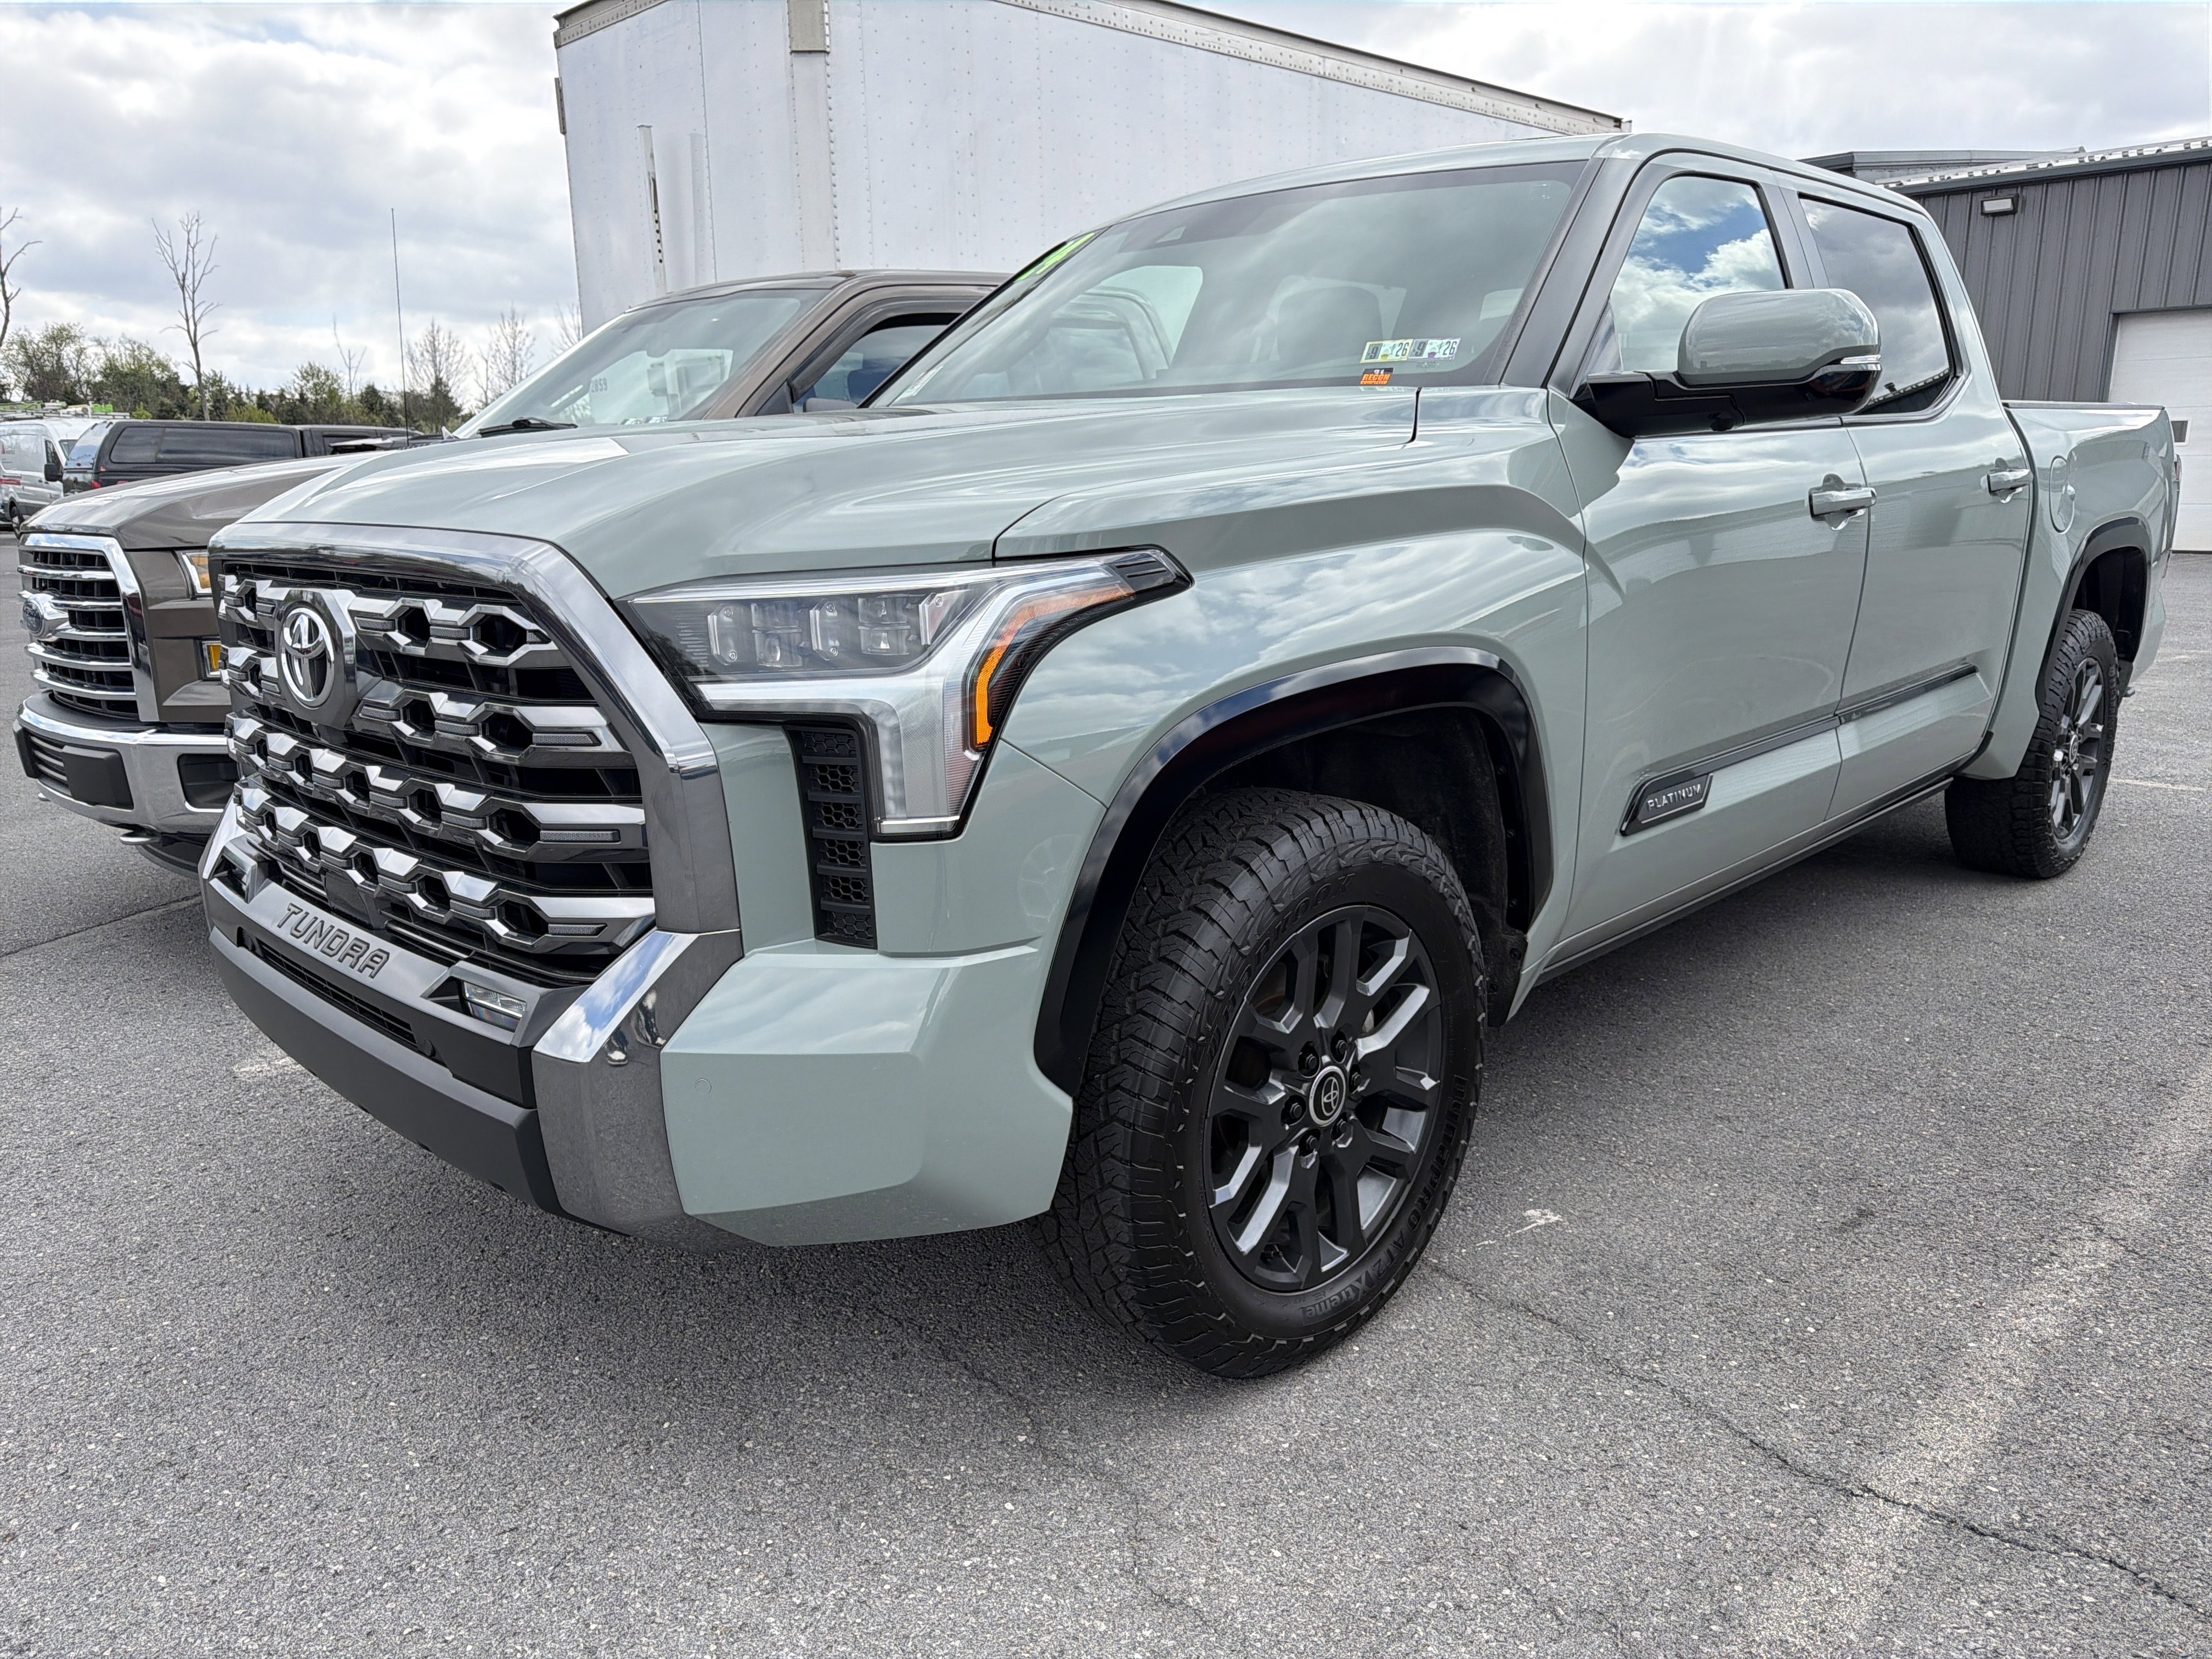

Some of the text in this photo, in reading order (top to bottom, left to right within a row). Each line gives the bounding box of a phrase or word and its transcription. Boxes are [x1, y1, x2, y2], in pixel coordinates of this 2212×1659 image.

[1395, 342, 1409, 357] 26
[1443, 341, 1457, 356] 26
[1647, 783, 1701, 811] PLATINUM
[276, 902, 390, 979] TUNDRA
[1305, 1271, 1371, 1320] Xtreme
